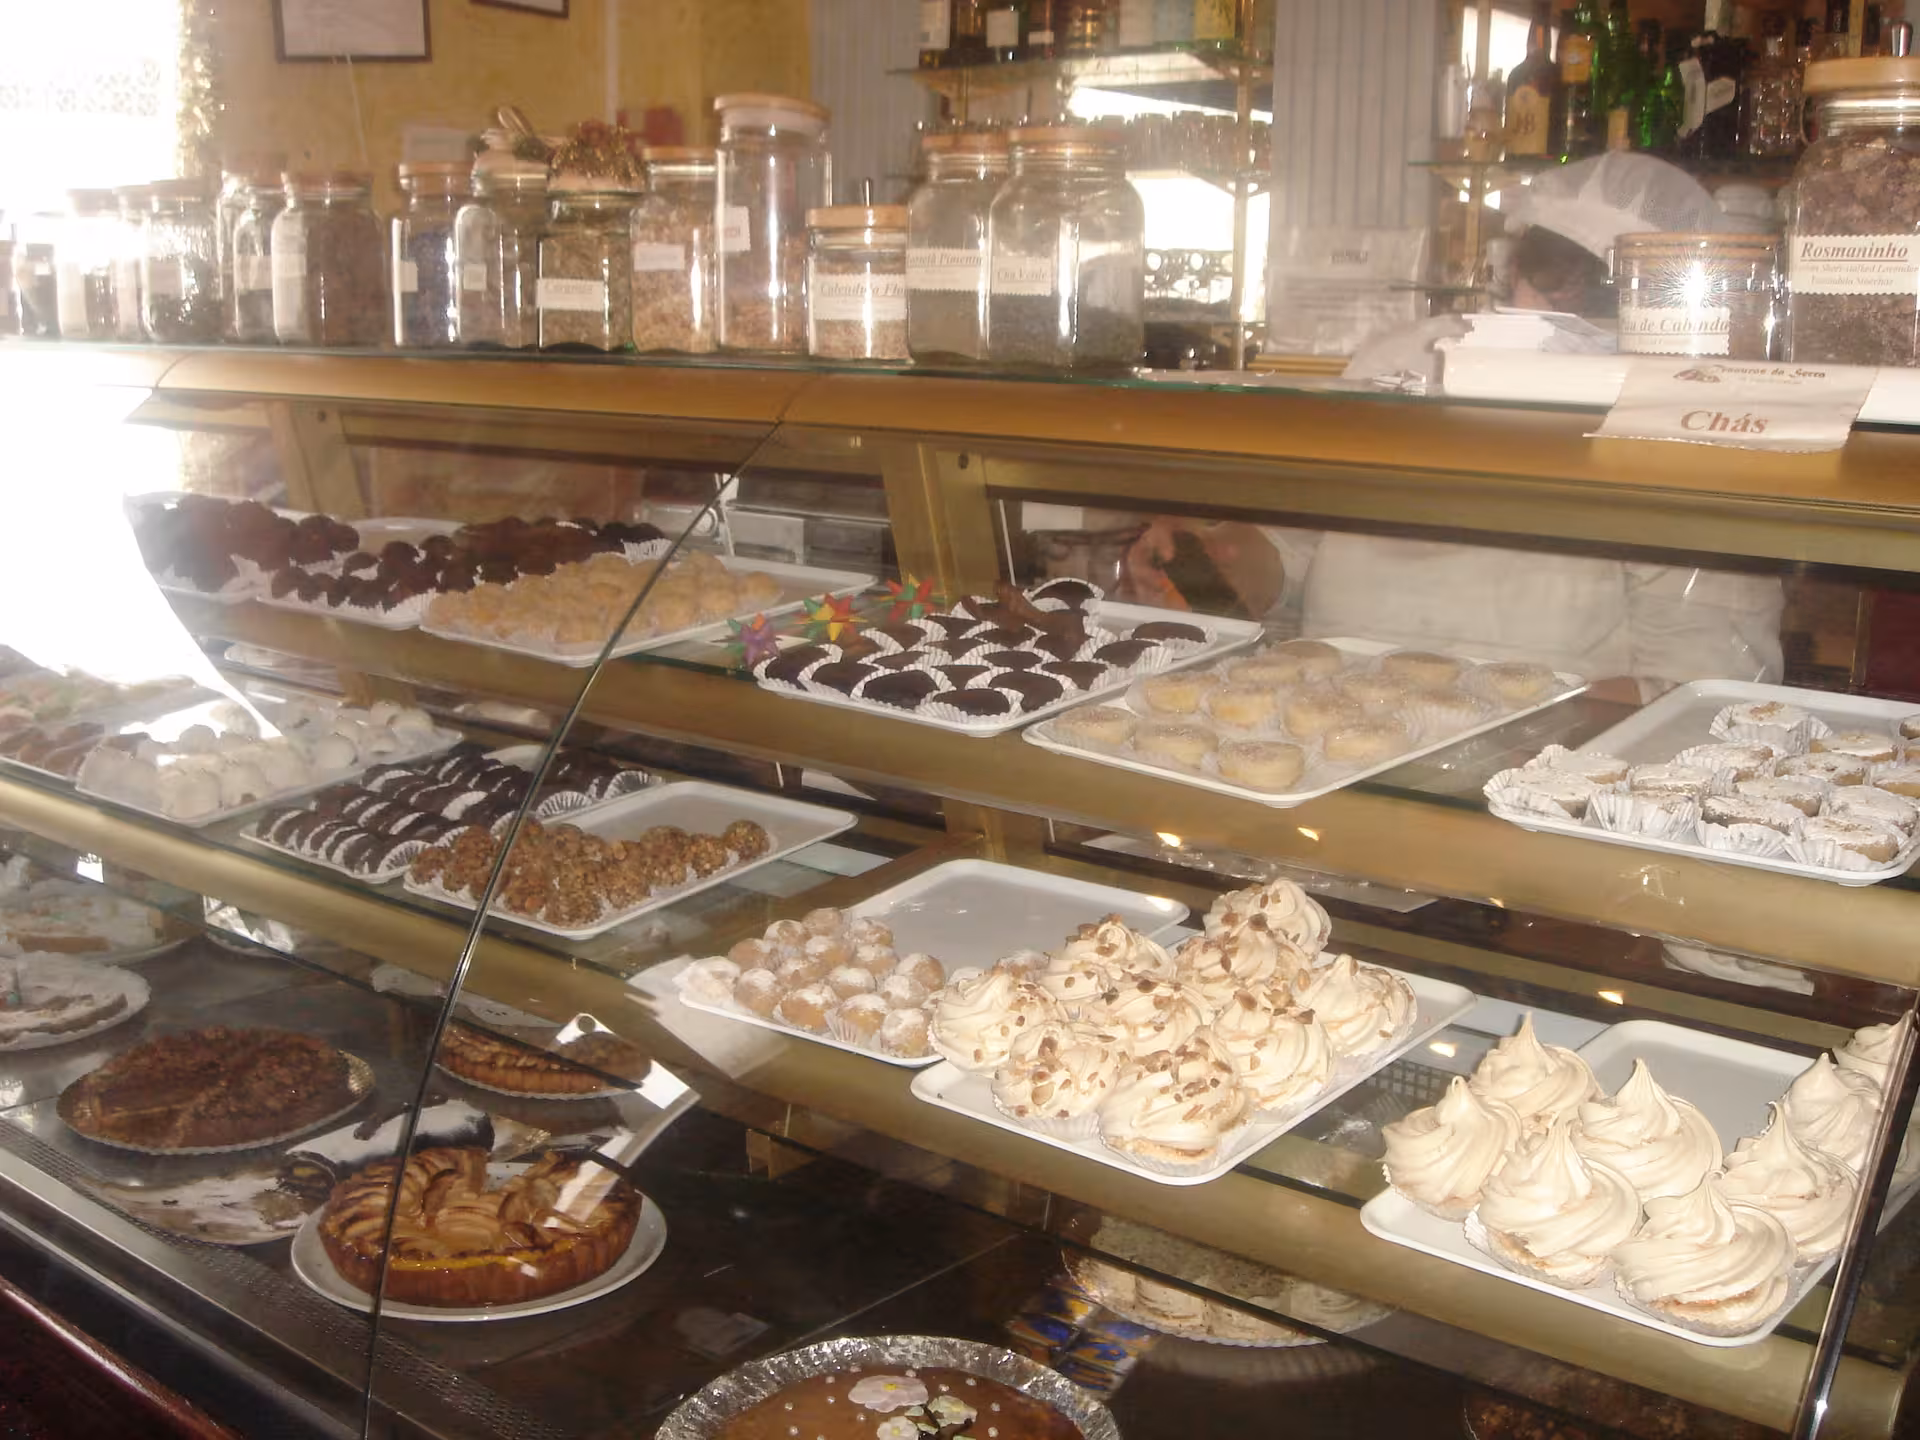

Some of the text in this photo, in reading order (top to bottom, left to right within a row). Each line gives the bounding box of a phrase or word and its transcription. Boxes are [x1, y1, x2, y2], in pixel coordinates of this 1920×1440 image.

[1799, 241, 1909, 259] Rosmaninho
[1640, 317, 1655, 331] de
[1680, 409, 1769, 434] Chás
